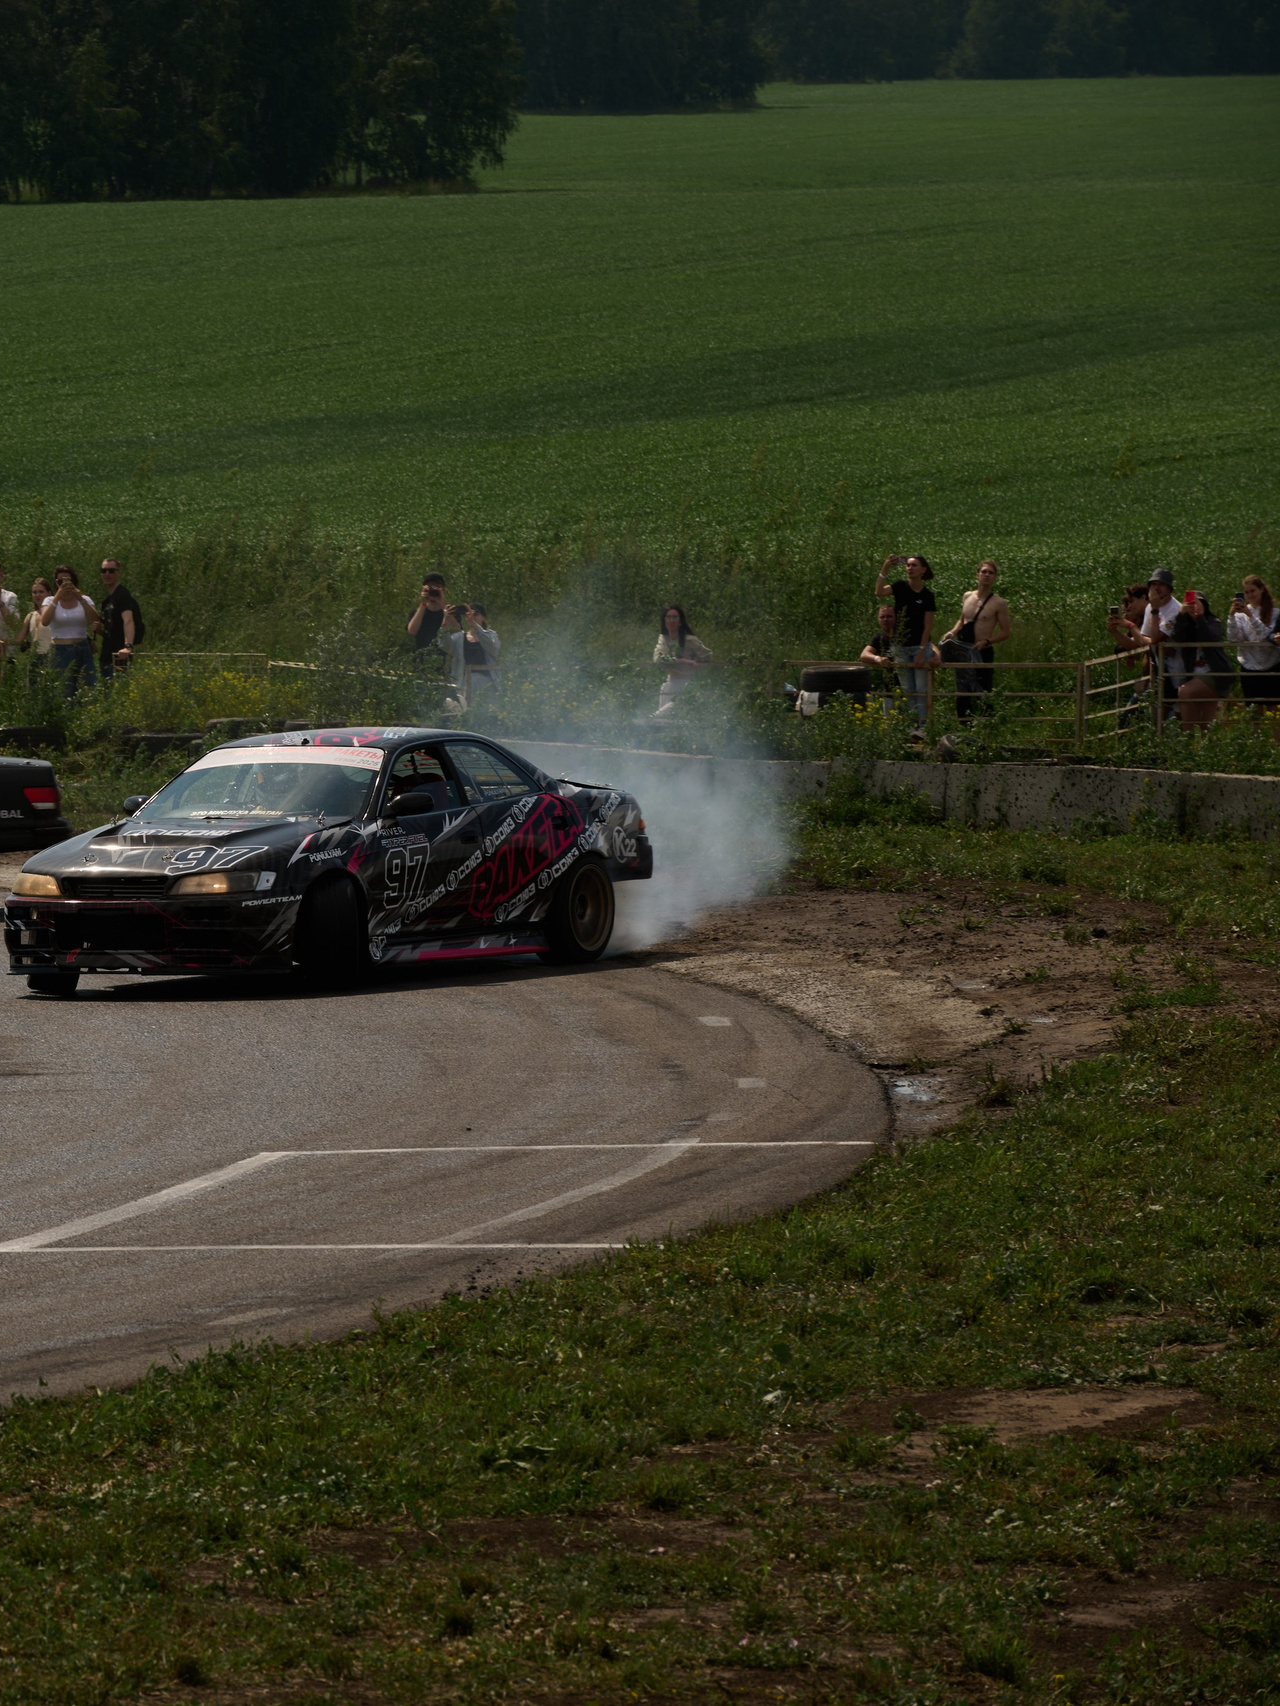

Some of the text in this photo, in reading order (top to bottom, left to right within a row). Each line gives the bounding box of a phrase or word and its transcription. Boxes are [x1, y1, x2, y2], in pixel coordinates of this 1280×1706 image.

[165, 845, 270, 876] 97
[308, 847, 343, 863] PONULYAM
[383, 842, 430, 909] 97
